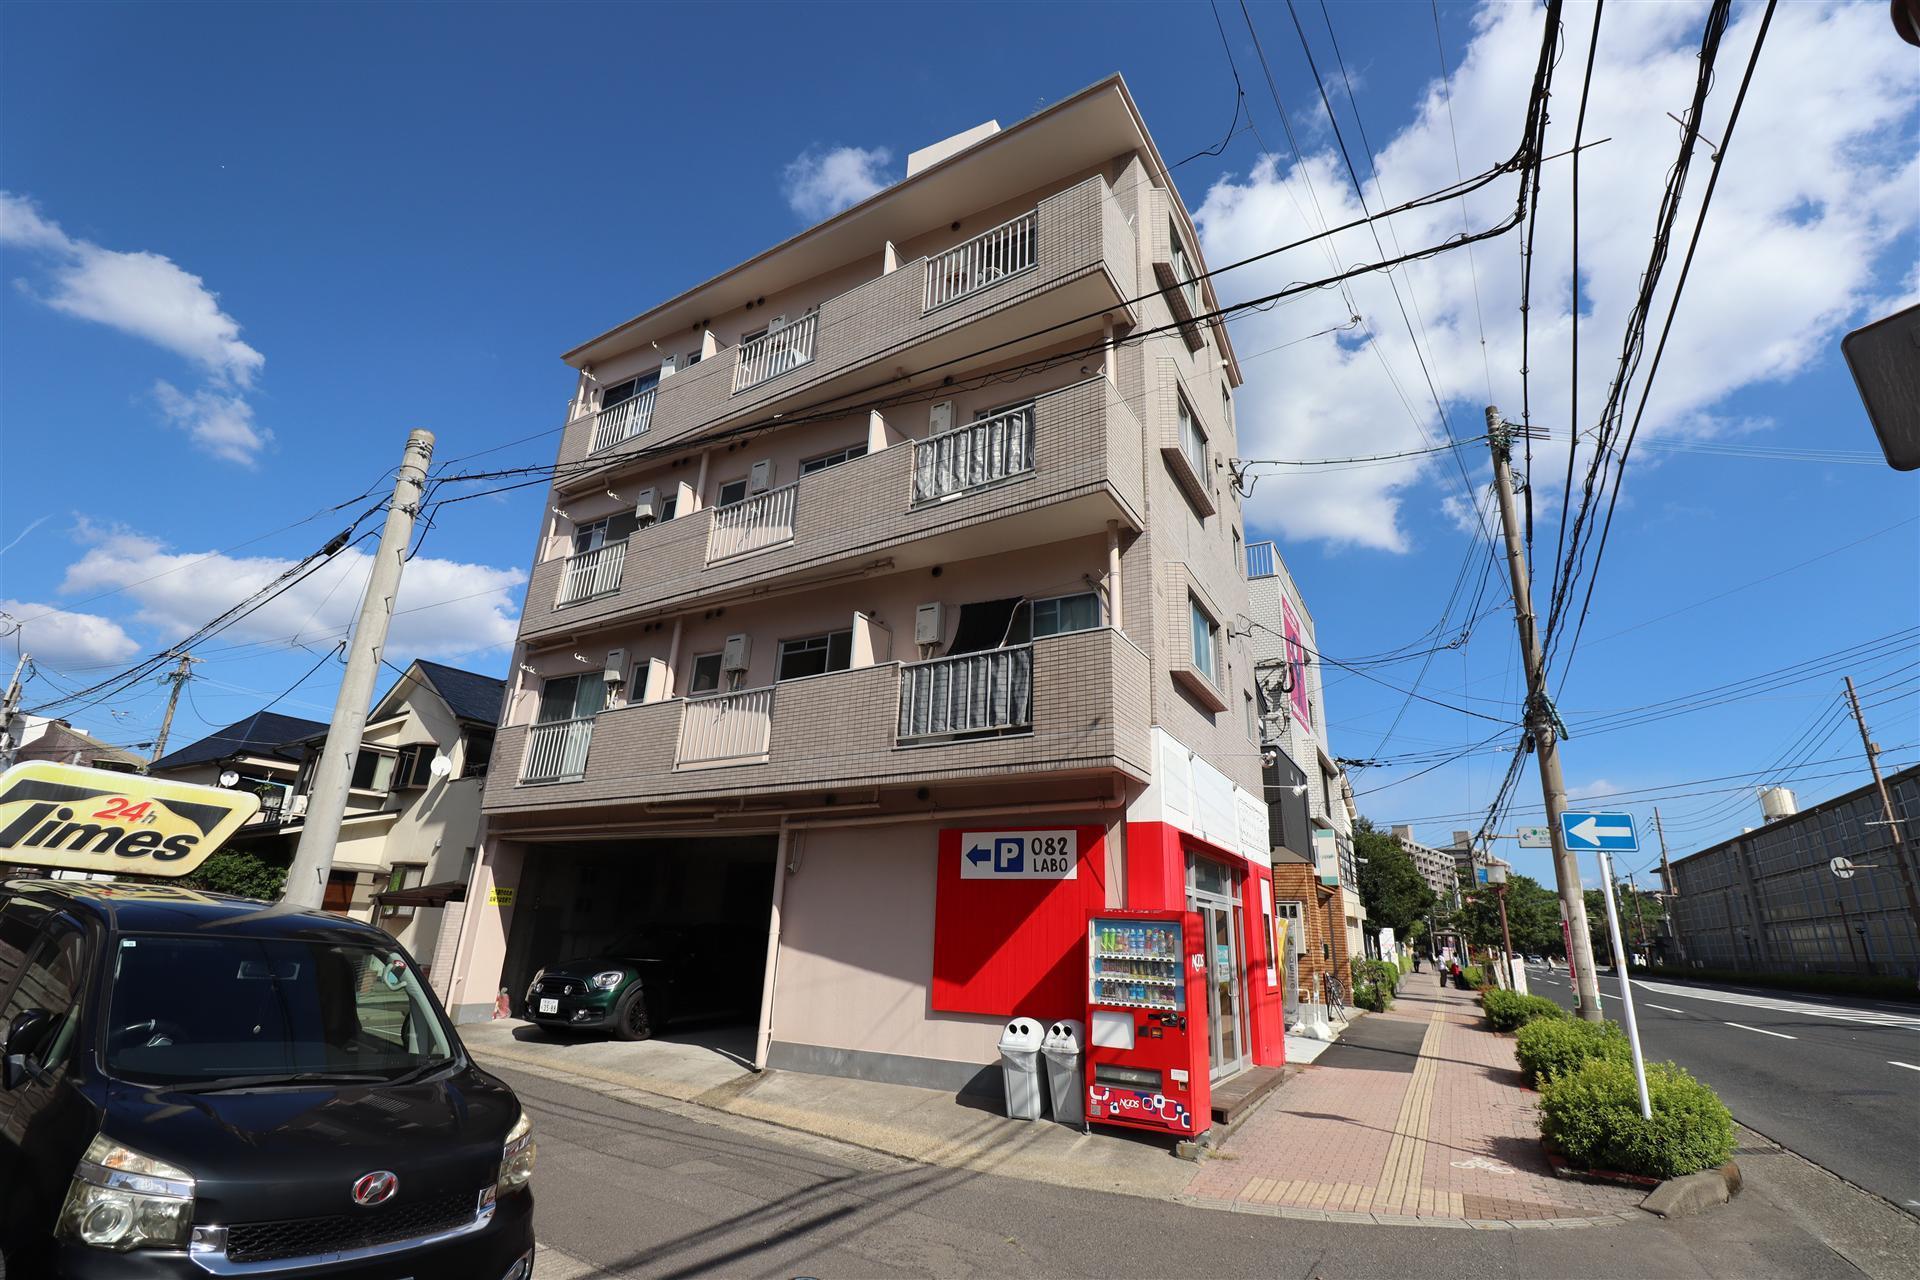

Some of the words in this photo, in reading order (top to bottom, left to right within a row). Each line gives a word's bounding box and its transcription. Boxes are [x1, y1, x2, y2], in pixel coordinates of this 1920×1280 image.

[0, 779, 199, 861] Times
[93, 797, 157, 824] 24h
[1001, 843, 1018, 867] P
[1033, 858, 1068, 873] LABO
